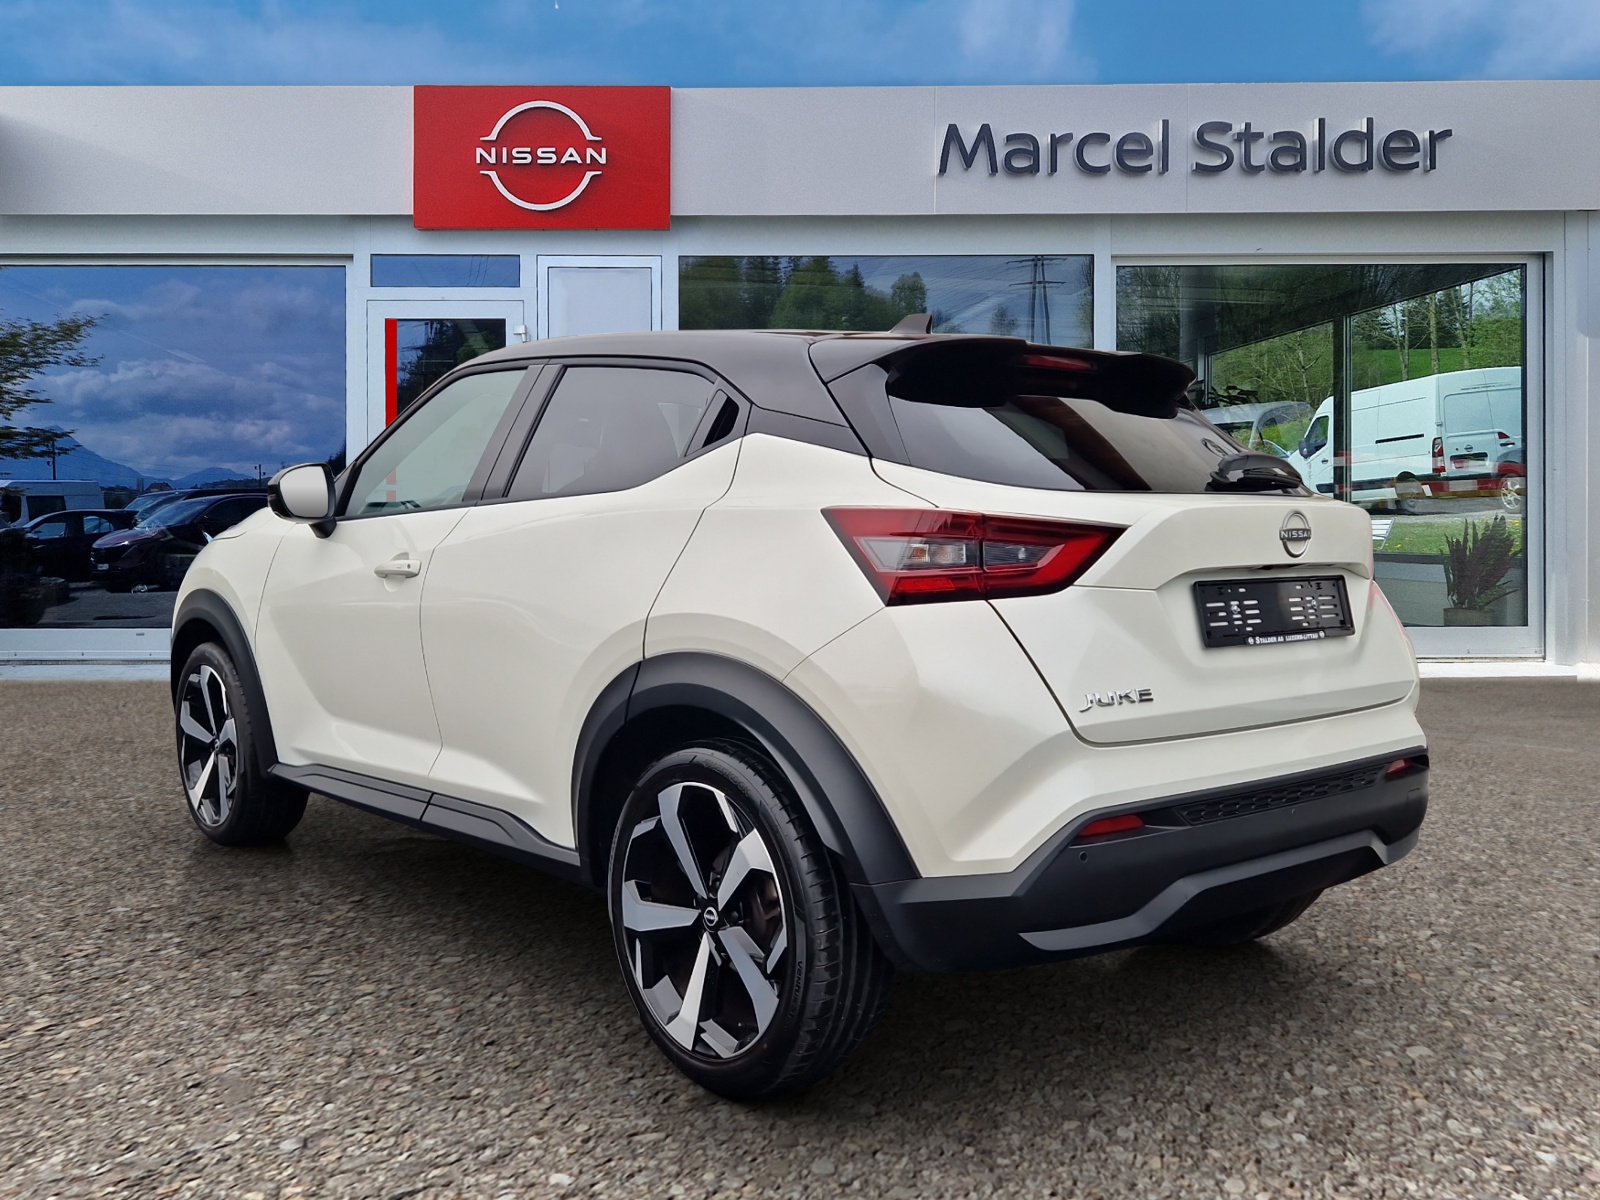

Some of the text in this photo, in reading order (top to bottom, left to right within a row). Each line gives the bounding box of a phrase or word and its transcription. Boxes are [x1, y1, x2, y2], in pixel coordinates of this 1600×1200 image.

[475, 147, 607, 164] NISSAN
[937, 117, 1452, 175] Marcel Stalder
[1280, 530, 1311, 538] NISSAN
[1079, 688, 1154, 713] JUKE
